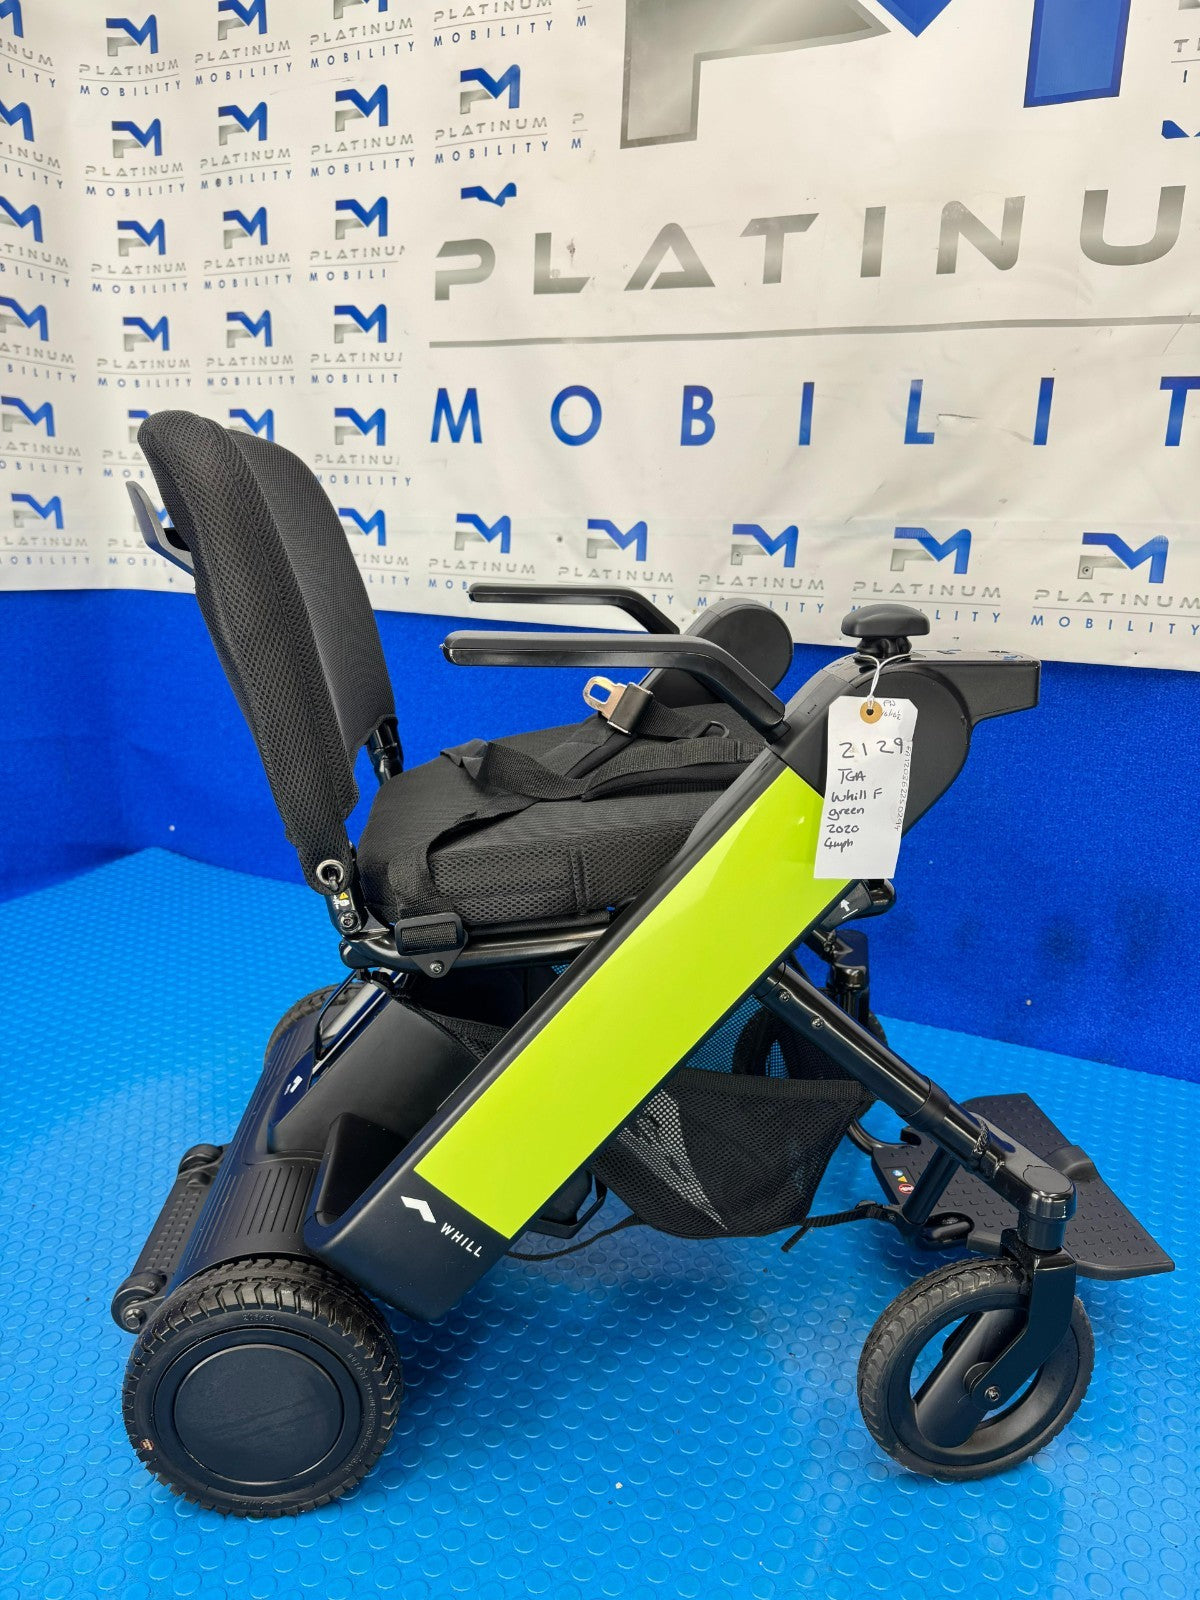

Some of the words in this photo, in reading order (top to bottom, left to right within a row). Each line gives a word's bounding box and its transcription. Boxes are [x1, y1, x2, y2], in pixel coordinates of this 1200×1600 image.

[310, 17, 414, 46] PLATINUM
[434, 20, 553, 48] MOBILITY
[194, 40, 291, 64] PLATINUM
[310, 42, 415, 69] MOBILITY
[79, 59, 179, 76] PLATINUM
[195, 62, 292, 86] MOBILITY
[80, 80, 181, 97] MOBILITY
[434, 116, 548, 141] PLATINUM
[311, 133, 414, 156] PLATINUM
[434, 140, 548, 165] MOBILITY
[200, 148, 291, 169] PLATINUM
[310, 157, 415, 177] MOBILITY
[85, 162, 183, 178] PLATINUM
[201, 169, 292, 190] MOBILITY
[86, 183, 185, 197] MOBILITY
[0, 243, 69, 268] TINUM
[203, 252, 291, 270] PLATINUM
[91, 262, 187, 275] PLATINUM
[91, 281, 189, 295] MOBILITY
[204, 274, 292, 291] MOBILITY
[97, 358, 190, 370] PLATINUM
[206, 354, 294, 367] PLATINUM
[97, 377, 192, 389] MOBILITY
[207, 374, 296, 387] MOBILITY
[0, 441, 81, 457] ATINUM
[314, 454, 400, 466] PLATINU
[428, 558, 536, 575] PLATINUM
[558, 566, 674, 584] PLATINUM
[698, 574, 824, 591] PLATINUM
[851, 581, 1001, 599] PLATINUM
[1034, 588, 1200, 610] PLATINUM
[1030, 614, 1200, 636] MOBILITY
[838, 768, 866, 785] TGA
[873, 787, 883, 800] F
[827, 807, 865, 821] green
[826, 824, 860, 834] 2020
[440, 1222, 483, 1258] WHILL
